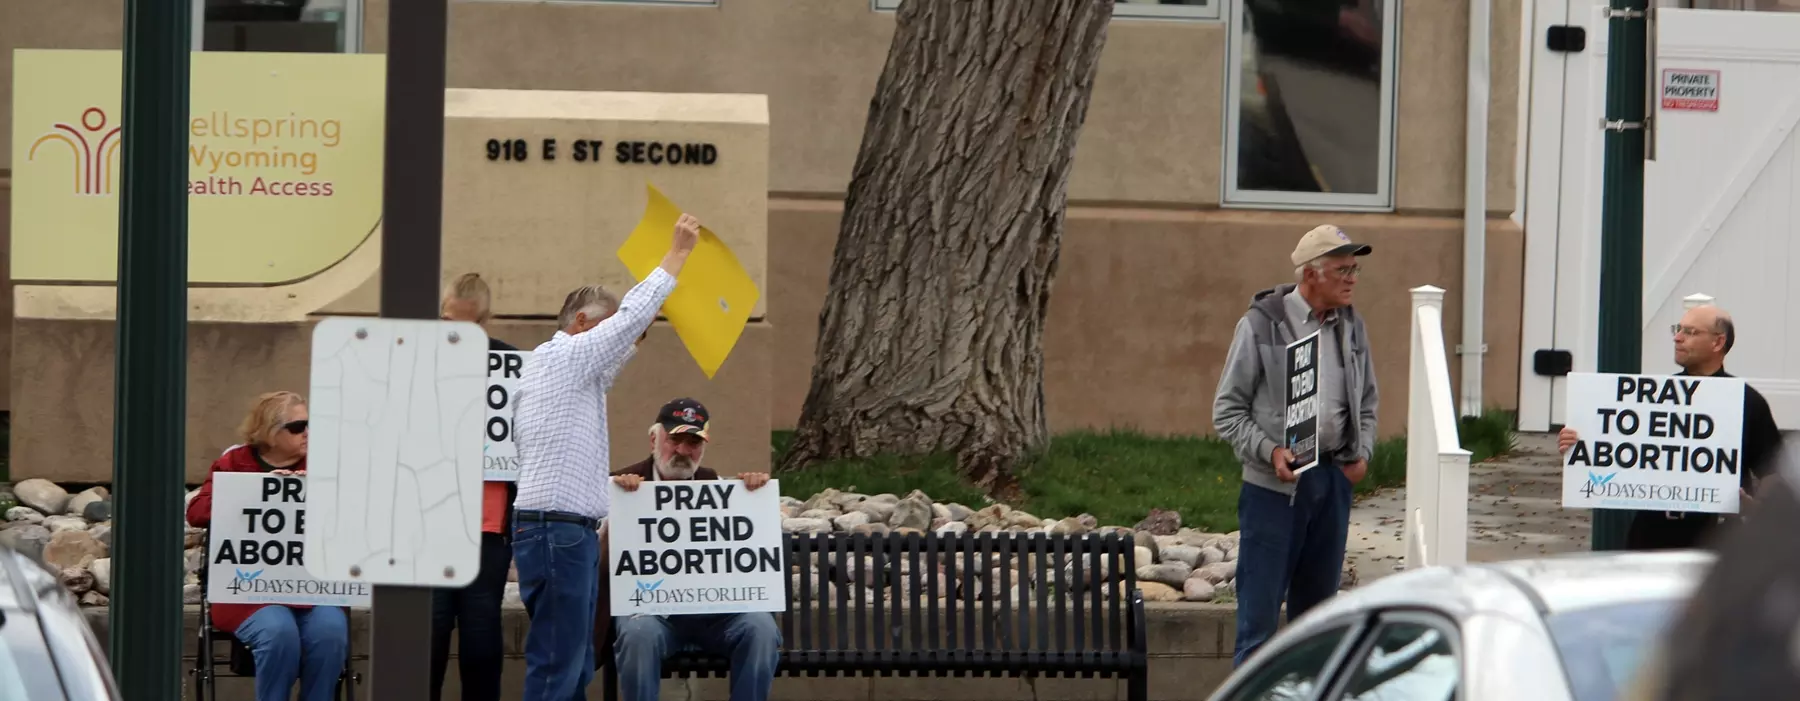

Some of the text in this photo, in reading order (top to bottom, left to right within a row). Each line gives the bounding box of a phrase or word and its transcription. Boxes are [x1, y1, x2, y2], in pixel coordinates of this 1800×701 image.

[1665, 86, 1715, 97] PROPERTY
[1671, 73, 1710, 85] PRIVATE
[190, 111, 341, 147] ellspring
[486, 139, 717, 165] 918 E ST SECOND
[250, 176, 333, 196] Access
[487, 353, 522, 378] PR
[487, 384, 508, 410] O
[1617, 376, 1701, 405] PRAY
[1597, 408, 1714, 439] TO END
[1568, 440, 1738, 475] ABORTION
[262, 477, 306, 503] PR
[655, 484, 735, 511] PRAY
[1579, 479, 1605, 498] 40
[1607, 482, 1647, 499] DAYS
[243, 508, 286, 534] TO
[638, 516, 753, 543] TO END
[214, 540, 304, 566] ABOR
[615, 547, 781, 576] ABORTION
[226, 576, 252, 595] 40
[254, 578, 294, 593] DAYS
[629, 588, 654, 607] 40
[654, 589, 694, 604] DAYS
